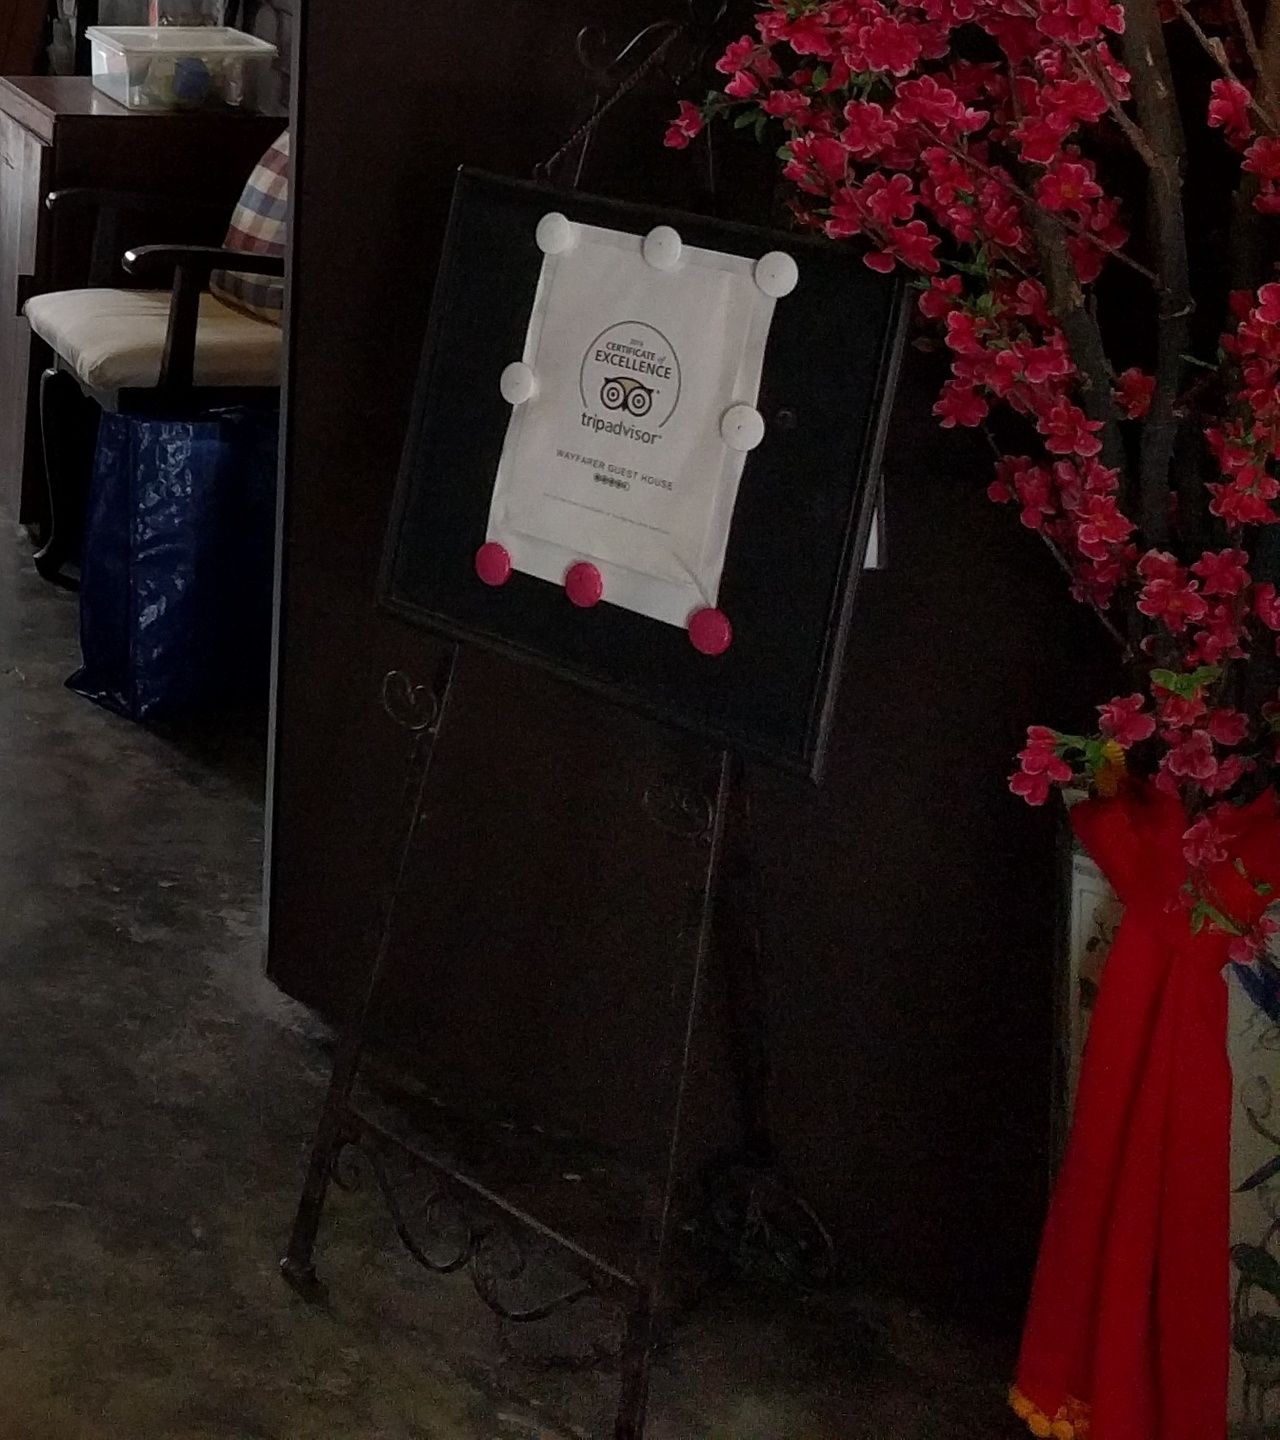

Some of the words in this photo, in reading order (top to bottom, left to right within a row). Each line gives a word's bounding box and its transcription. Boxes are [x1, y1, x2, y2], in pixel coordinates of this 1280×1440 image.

[594, 349, 672, 380] EXCELLENCE
[605, 341, 656, 362] CERTIFICATE
[581, 411, 662, 445] tripadvisor
[556, 447, 605, 471] WAYFARER
[607, 462, 639, 479] GUEST
[640, 473, 673, 492] HOUSE
